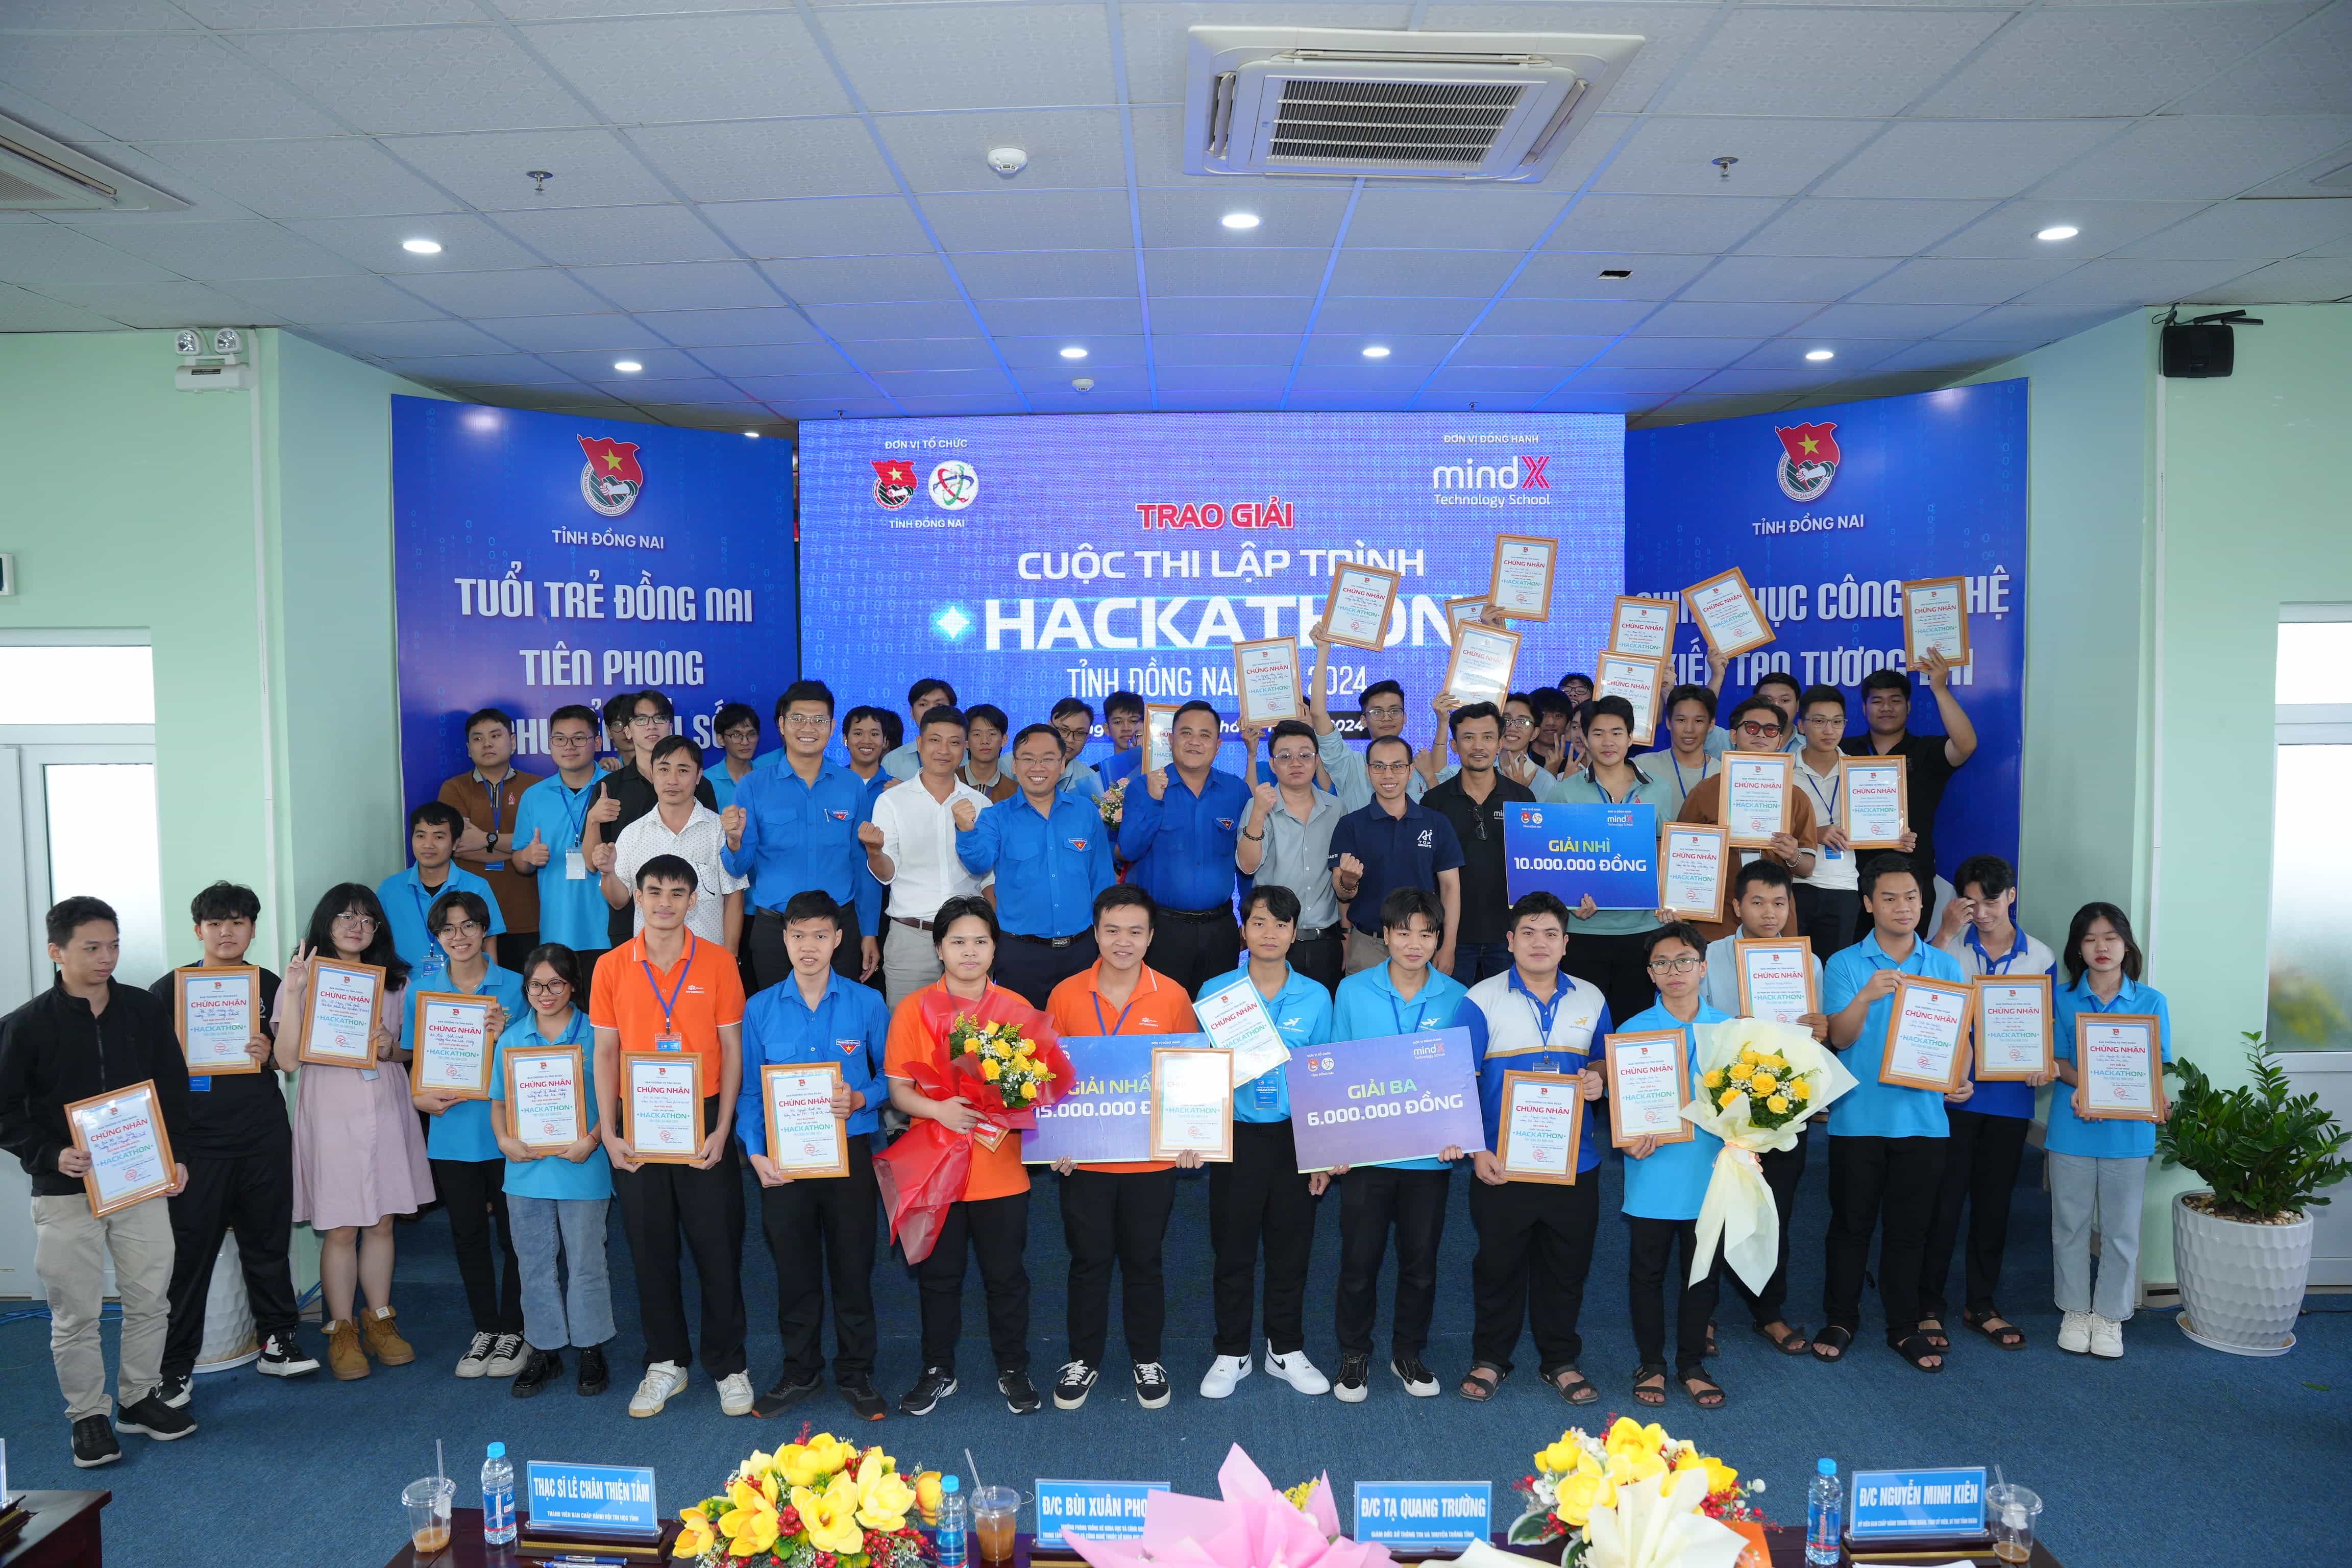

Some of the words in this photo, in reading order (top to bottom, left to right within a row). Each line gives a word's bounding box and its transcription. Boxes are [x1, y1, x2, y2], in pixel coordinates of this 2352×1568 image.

[885, 440, 907, 449] ĐƠN
[910, 440, 919, 450] VỊ
[922, 436, 936, 448] TỔ
[938, 437, 968, 448] CHỨC
[1443, 434, 1465, 444] ĐƠN
[1468, 435, 1477, 445] VỊ
[1480, 432, 1509, 443] ĐỒNG
[1433, 455, 1551, 489] mindX
[1434, 494, 1505, 508] Technology
[1509, 494, 1550, 505] School
[1136, 502, 1225, 531] TRAO
[1230, 496, 1293, 530] GIẢI
[1752, 516, 1787, 535] TỈNH
[1790, 512, 1834, 533] ĐỒNG
[1837, 513, 1864, 530] NAI
[552, 526, 588, 546] TỈNH
[591, 528, 635, 548] ĐỒNG
[640, 534, 664, 549] NAI
[1018, 542, 1125, 583] CUỘC
[1134, 550, 1200, 578] THI
[1211, 540, 1291, 583] LẬP
[1299, 538, 1425, 577] TRÌNH
[455, 561, 533, 617] TUỔI
[544, 569, 604, 619] TRẺ
[614, 570, 695, 622] ĐỒNG
[705, 587, 752, 623] NAI
[1342, 587, 1365, 596] CHỨNG
[1751, 584, 1807, 627] HỤC
[1818, 573, 1903, 620] CÔNG
[1965, 565, 2010, 621] HỆ
[1703, 600, 1725, 612] CHỨNG
[1724, 594, 1743, 604] NHẬN
[519, 641, 592, 686] TIÊN
[603, 650, 703, 686] PHONG
[1246, 666, 1269, 674] CHỨNG
[1066, 658, 1120, 698] TỈNH
[1129, 656, 1192, 697] ĐỒNG
[1760, 781, 1781, 790] NHẬN
[1608, 815, 1633, 823] mindX
[1549, 837, 1579, 852] GIẢI
[1583, 838, 1610, 852] NHÌ
[1514, 857, 1596, 873] 10.000.000
[1599, 853, 1647, 872] ĐỒNG
[1781, 971, 1803, 979] NHẬN
[191, 998, 220, 1008] CHỨNG
[222, 998, 247, 1008] NHẬN
[321, 991, 347, 1000] CHỨNG
[348, 994, 370, 1003] NHẬN
[1211, 1014, 1237, 1030] CHỨNG
[1236, 1003, 1258, 1018] NHẬN
[1905, 1010, 1933, 1020] CHỨNG
[1934, 1014, 1957, 1024] NHẬN
[1988, 1006, 2015, 1014] CHỨNG
[2017, 1006, 2039, 1015] NHẬN
[320, 1016, 365, 1025] HACKATHON
[429, 1023, 457, 1032] CHỨNG
[458, 1025, 481, 1035] NHẬN
[1902, 1036, 1948, 1047] HACKATHON
[2090, 1044, 2119, 1052] CHỨNG
[2121, 1045, 2145, 1054] NHẬN
[1413, 1043, 1445, 1056] mindX
[1621, 1066, 1649, 1075] CHỨNG
[1650, 1064, 1673, 1073] NHẬN
[520, 1080, 547, 1088] CHỨNG
[548, 1078, 571, 1087] NHẬN
[637, 1085, 665, 1093] CHỨNG
[667, 1086, 690, 1095] NHẬN
[1068, 1076, 1104, 1095] GIẢI
[1110, 1071, 1152, 1094] NHẤ
[1348, 1079, 1385, 1099] GIẢI
[1389, 1078, 1417, 1094] BA
[779, 1097, 806, 1106] CHỨNG
[807, 1096, 830, 1105] NHẬN
[1307, 1102, 1401, 1126] 6.000.000
[1405, 1090, 1463, 1114] ĐỒNG
[1036, 1101, 1136, 1118] 15.000.000
[1516, 1104, 1545, 1113] CHỨNG
[1546, 1106, 1570, 1115] NHẬN
[90, 1126, 121, 1141] CHỨNG
[121, 1119, 148, 1133] NHẬN
[99, 1145, 152, 1165] HACKATHON
[534, 1478, 555, 1501] THẠC
[557, 1476, 566, 1498] SĨ
[568, 1476, 578, 1499] LÊ
[580, 1477, 603, 1500] CHÂN
[605, 1478, 629, 1505] THIỆN
[631, 1479, 650, 1502] TÂM
[1859, 1487, 1877, 1507] Đ/C
[1880, 1479, 1921, 1506] NGUYỄN
[1924, 1485, 1952, 1505] MINH
[1954, 1480, 1978, 1504] KIÊN
[1042, 1496, 1062, 1515] Đ/C
[1066, 1493, 1086, 1516] BÙI
[1089, 1493, 1121, 1516] XUÂN
[1125, 1498, 1147, 1517] PHO
[1361, 1498, 1380, 1517] Đ/C
[1383, 1498, 1398, 1522] TẠ
[1401, 1498, 1438, 1519] QUANG
[1441, 1493, 1486, 1517] TRƯỜNG
